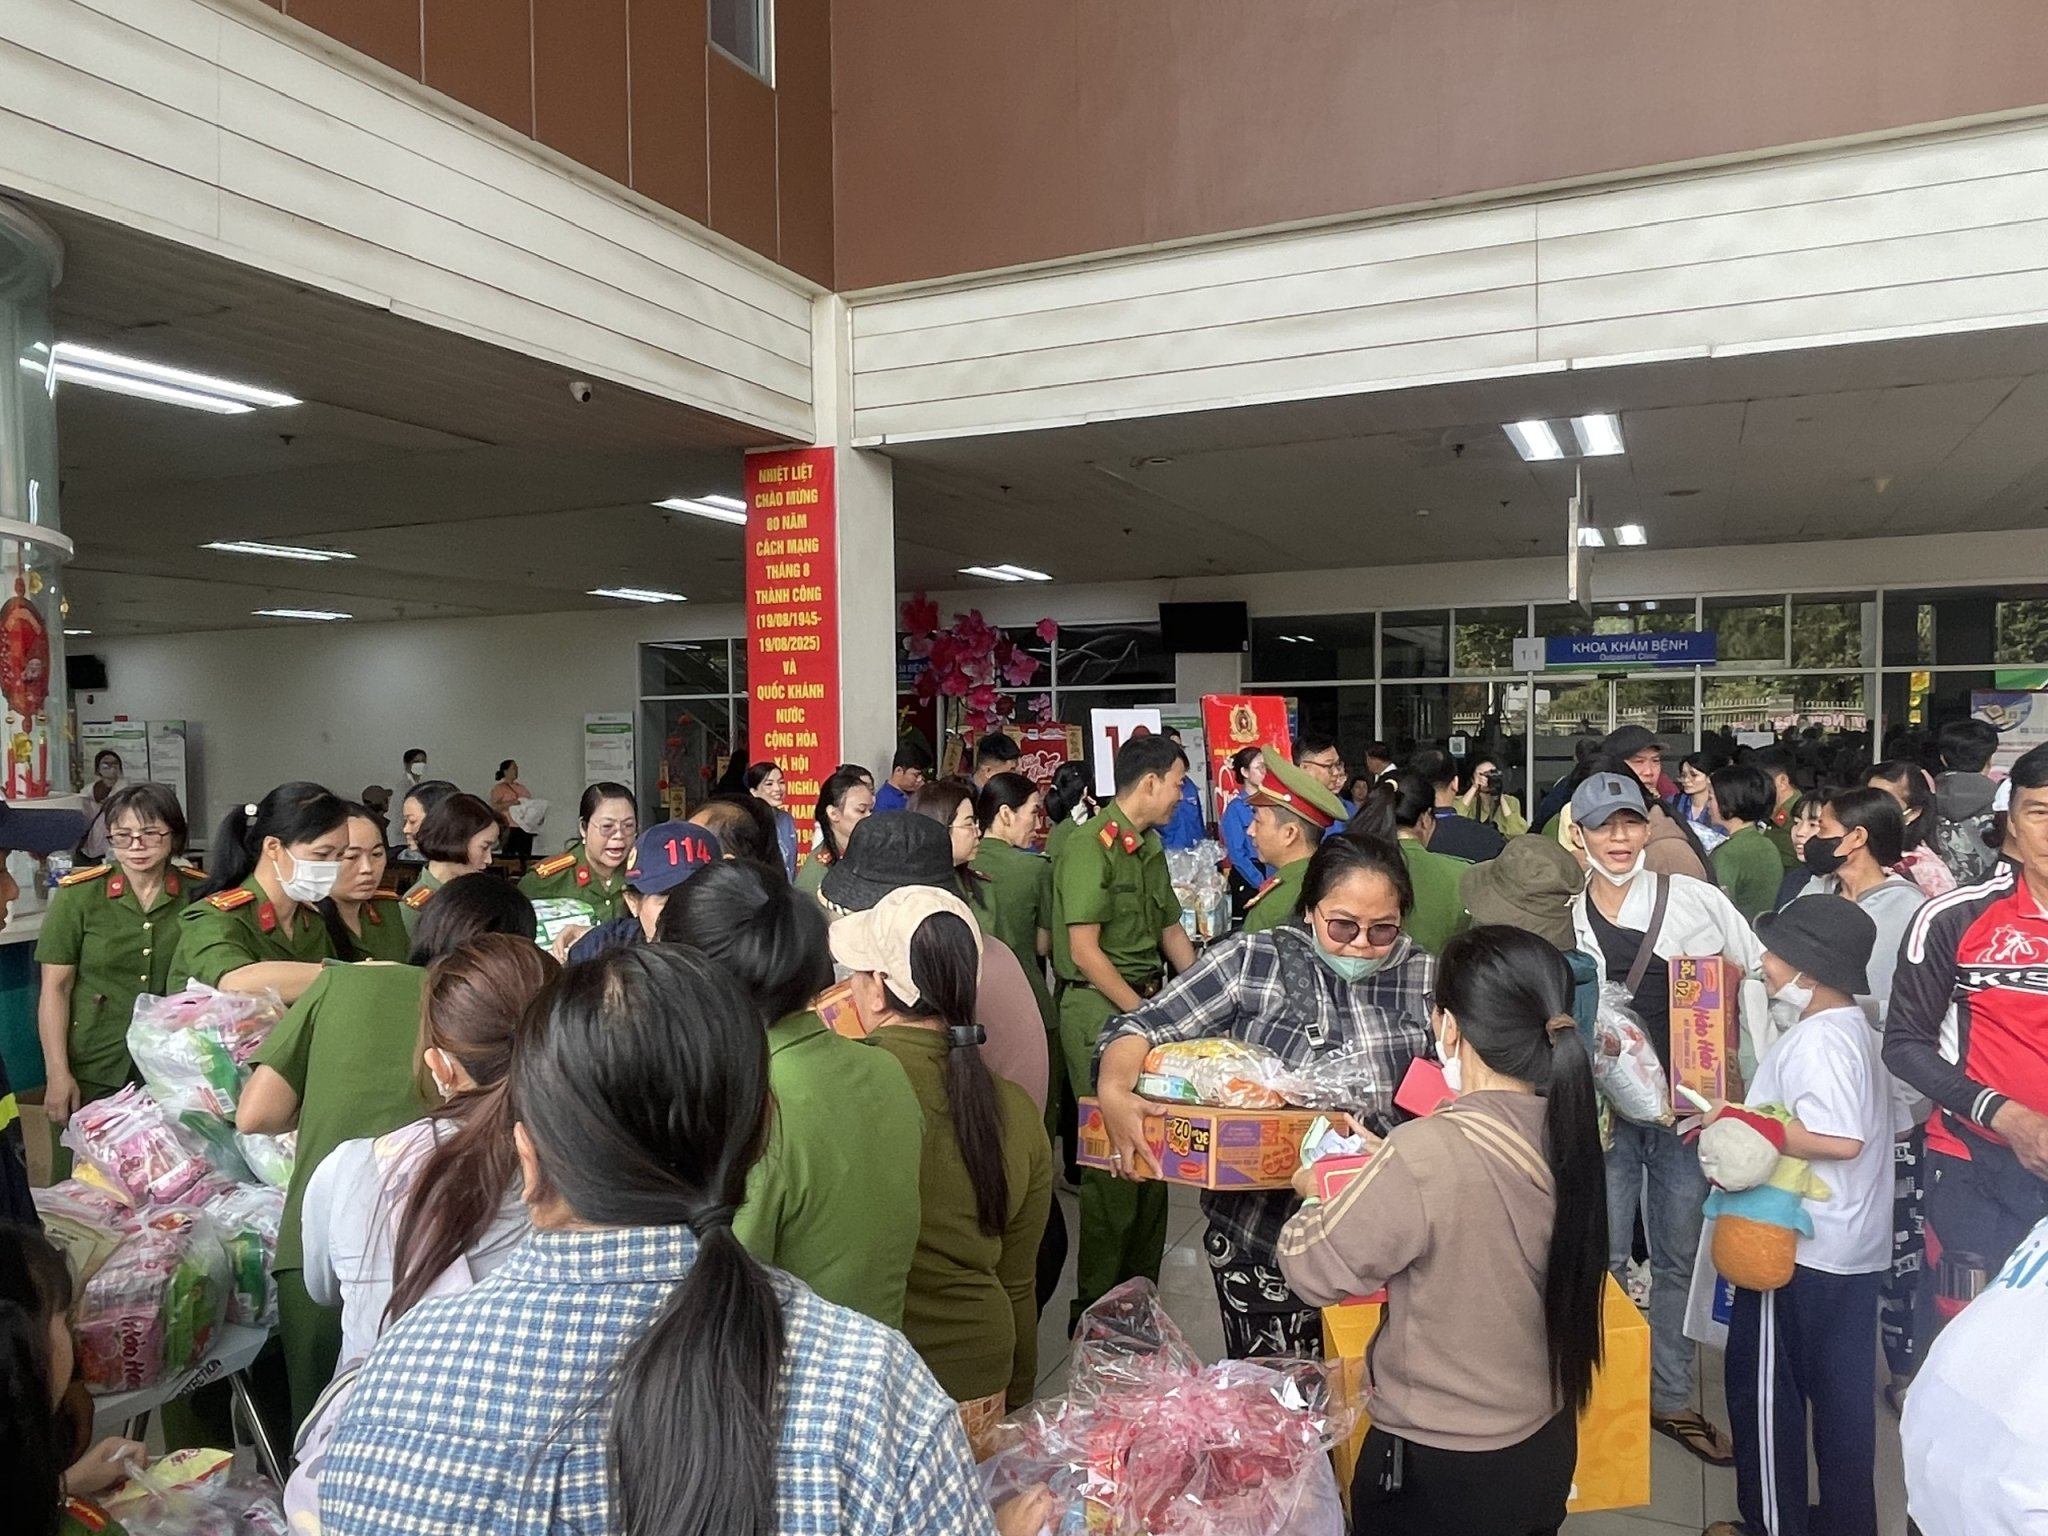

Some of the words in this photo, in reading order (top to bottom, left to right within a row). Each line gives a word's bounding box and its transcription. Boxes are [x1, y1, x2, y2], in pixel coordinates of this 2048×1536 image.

[759, 465, 789, 485] NHIỆT
[792, 463, 813, 482] LIỆT
[755, 490, 783, 508] CHÀO
[786, 487, 818, 505] MỪNG
[766, 517, 780, 531] 80
[782, 512, 807, 530] NĂM
[756, 538, 784, 556] CÁCH
[787, 538, 819, 556] MẠNG
[766, 562, 800, 579] THÁNG
[803, 562, 810, 577] 8
[755, 587, 790, 604] THÀNH
[792, 584, 822, 602] CÔNG
[756, 612, 822, 629] (19/08/1945-
[759, 636, 820, 652] 19/08/2025)
[1572, 642, 1607, 654] KHOA
[1612, 639, 1648, 652] KHÁM
[1652, 638, 1688, 653] BỆNH
[782, 657, 797, 675] VÀ
[757, 680, 785, 701] QUỐC
[787, 681, 824, 699] KHÁNH
[776, 706, 805, 723] NƯỚC
[764, 730, 793, 750] CỘNG
[796, 730, 818, 747] HÒA
[774, 754, 788, 771] XÃ
[791, 755, 809, 774] HỘI
[787, 778, 820, 795] NGHĨA
[664, 837, 711, 865] 114
[1675, 981, 1689, 996] 02
[1175, 1119, 1190, 1138] 02
